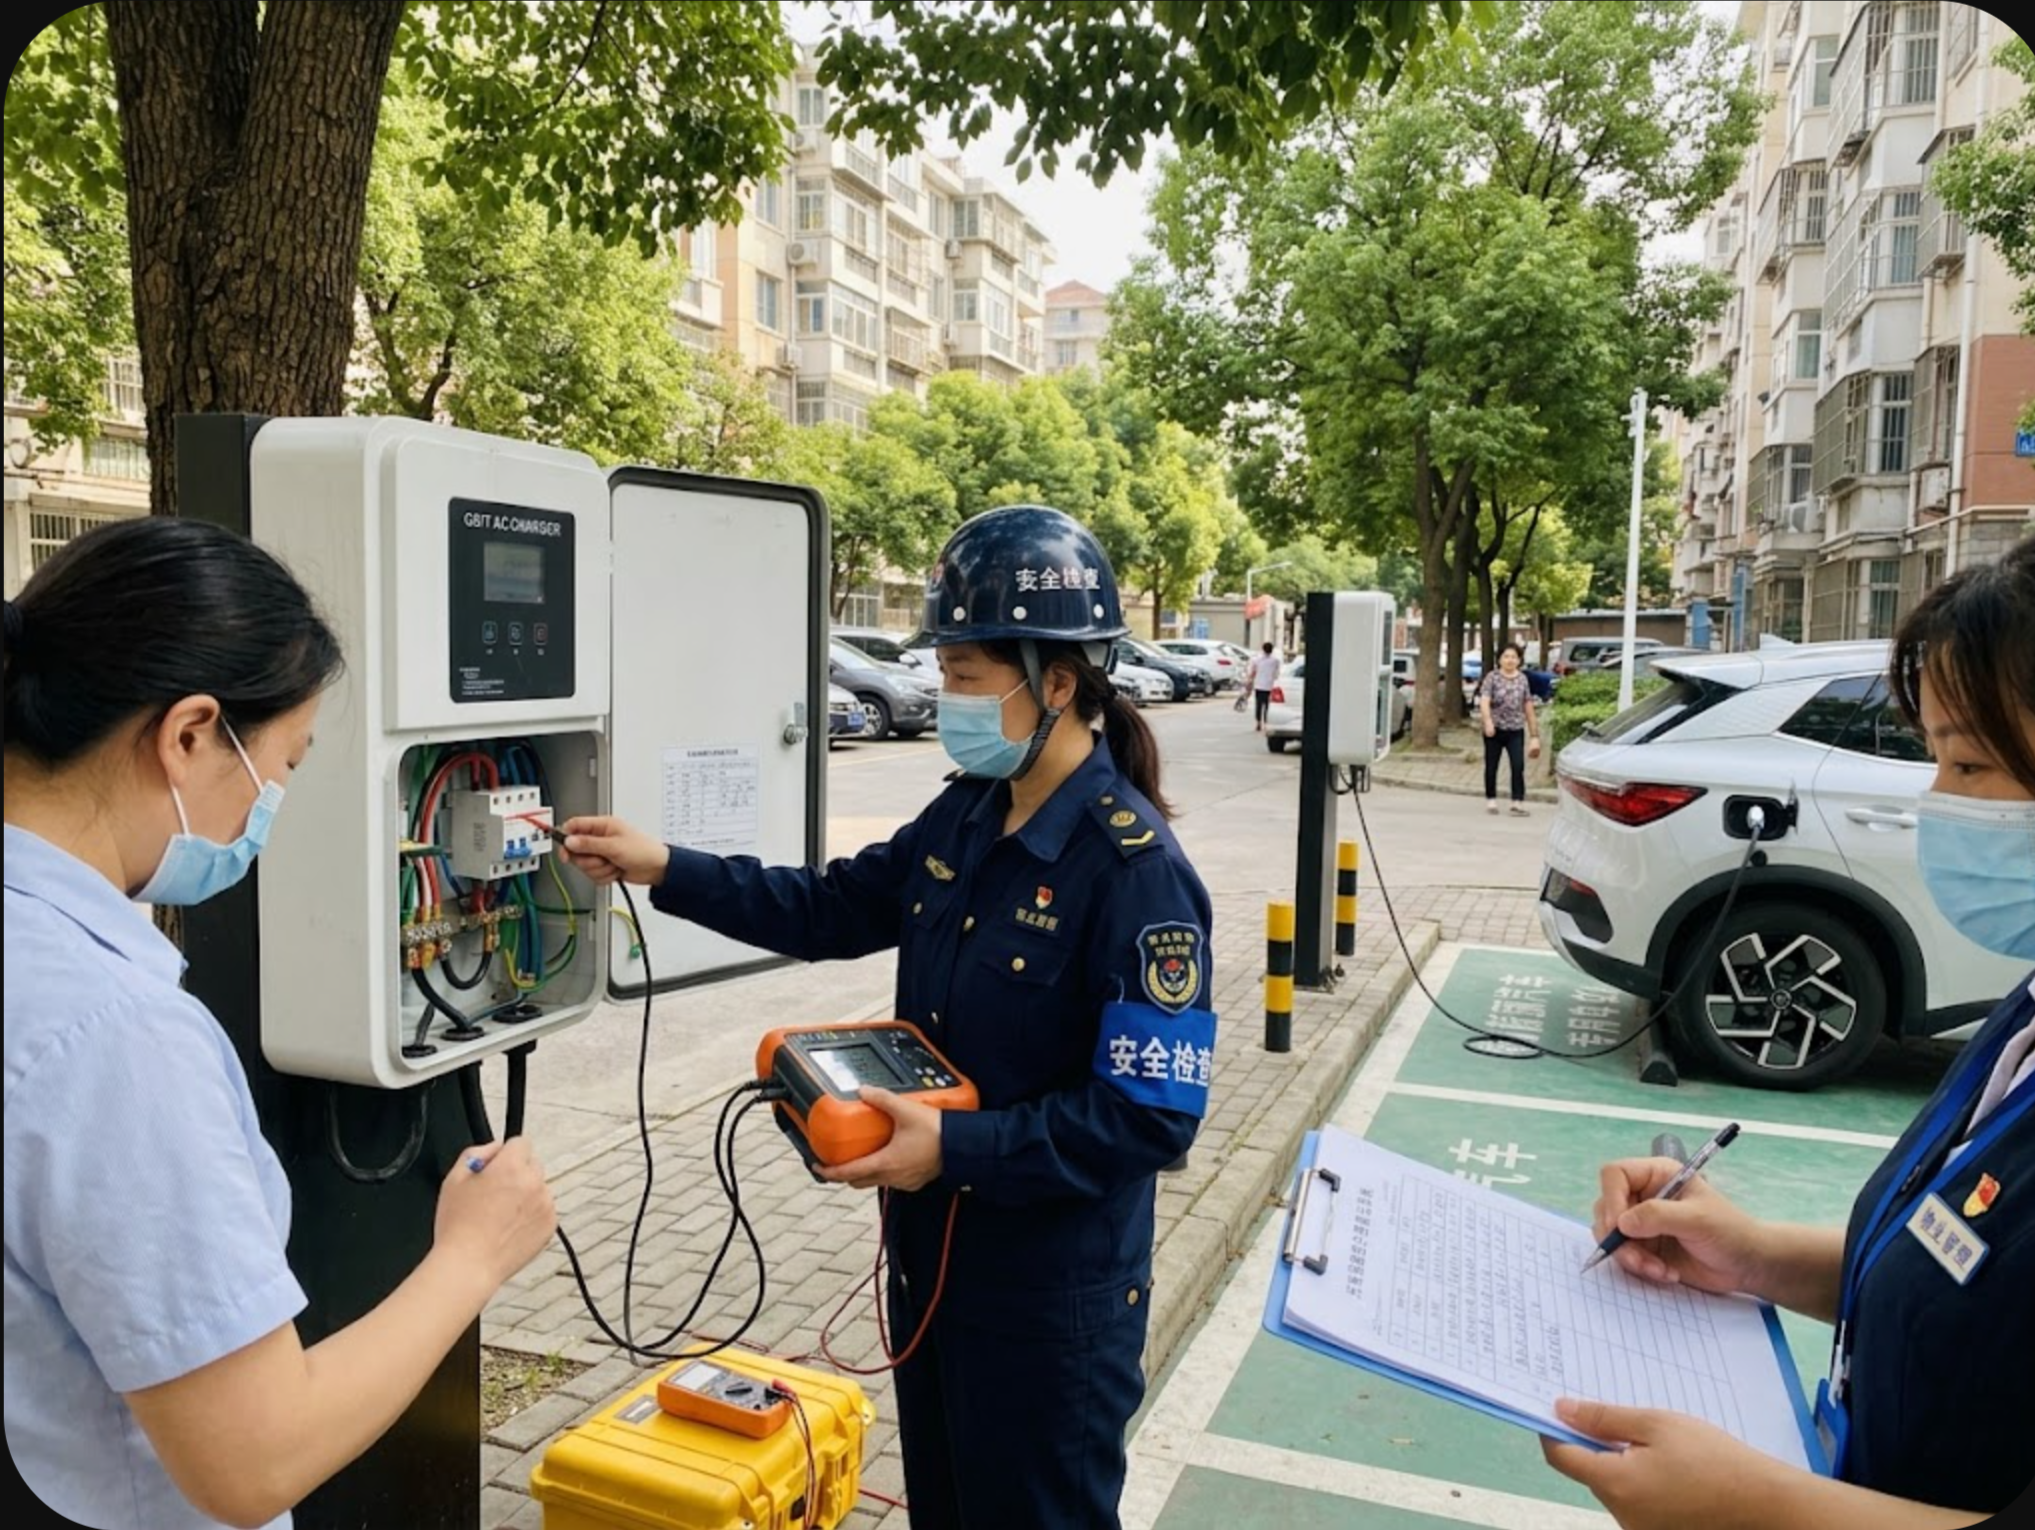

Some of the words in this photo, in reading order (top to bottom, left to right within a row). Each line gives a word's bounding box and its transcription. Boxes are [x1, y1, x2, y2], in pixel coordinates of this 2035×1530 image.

[1015, 566, 1101, 592] 安全检查
[1109, 1035, 1212, 1088] 安全检查
